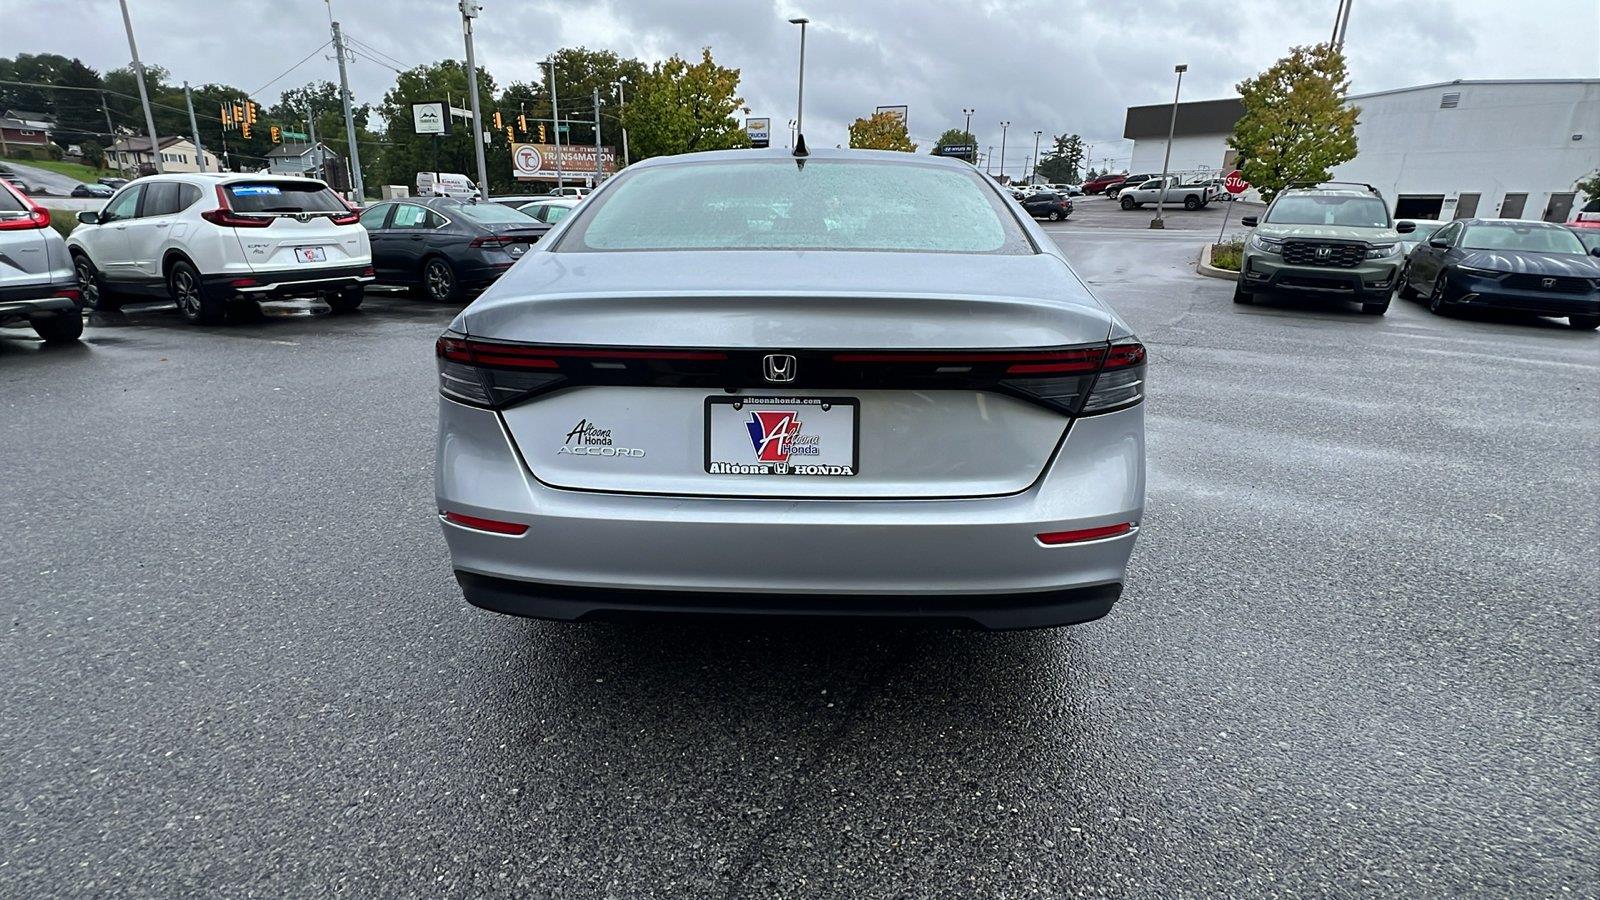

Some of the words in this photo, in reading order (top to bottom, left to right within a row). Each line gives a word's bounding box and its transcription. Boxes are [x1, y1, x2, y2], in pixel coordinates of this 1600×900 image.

[544, 152, 614, 162] TRANS4MATON
[565, 418, 612, 445] Altoona
[758, 416, 818, 455] Altoona
[585, 436, 612, 446] Honda
[557, 446, 646, 458] ACCORD
[782, 444, 818, 455] Honda
[710, 462, 768, 474] Altoona
[794, 465, 854, 476] HONDA
